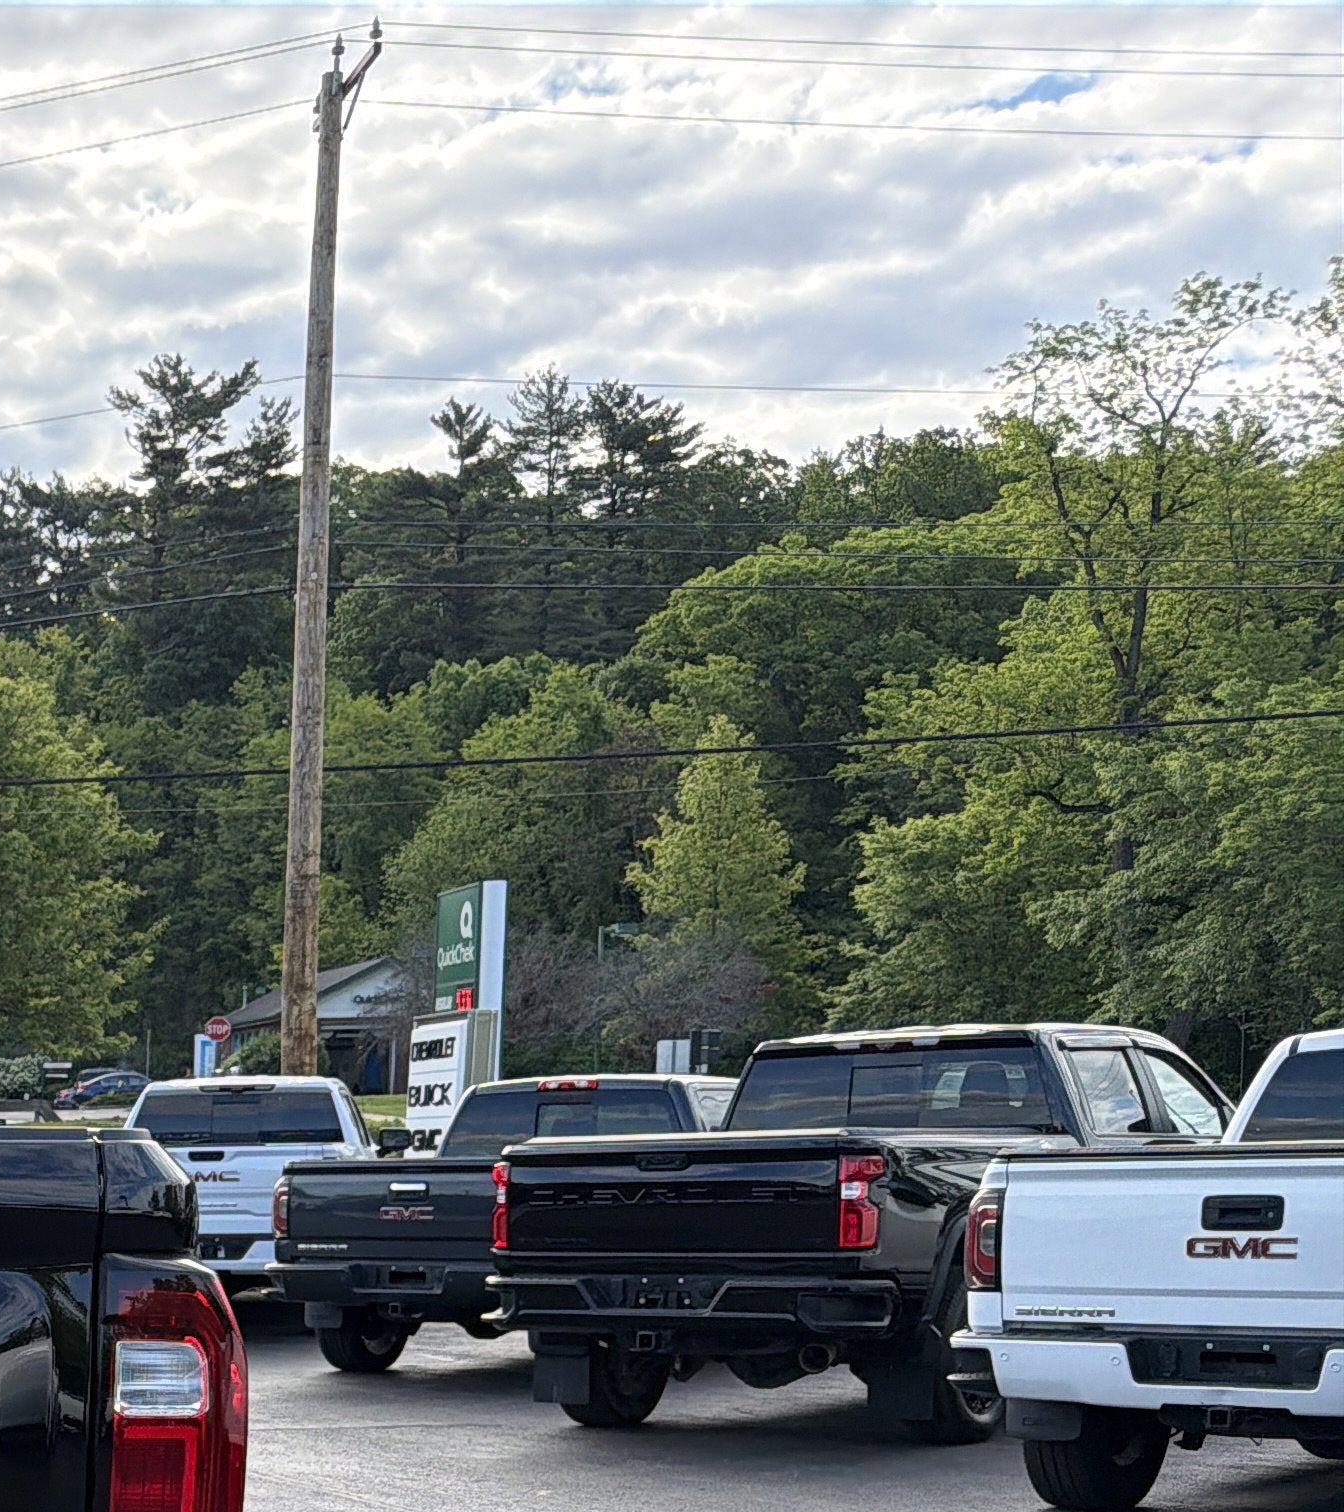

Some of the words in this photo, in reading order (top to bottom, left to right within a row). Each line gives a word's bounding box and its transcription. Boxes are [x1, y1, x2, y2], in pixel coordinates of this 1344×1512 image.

[207, 1022, 229, 1035] STOP
[408, 1082, 452, 1107] BUICK
[187, 1170, 240, 1183] MC
[379, 1206, 435, 1221] GMC
[1186, 1237, 1299, 1260] GMC
[1015, 1305, 1116, 1318] SIERRA
